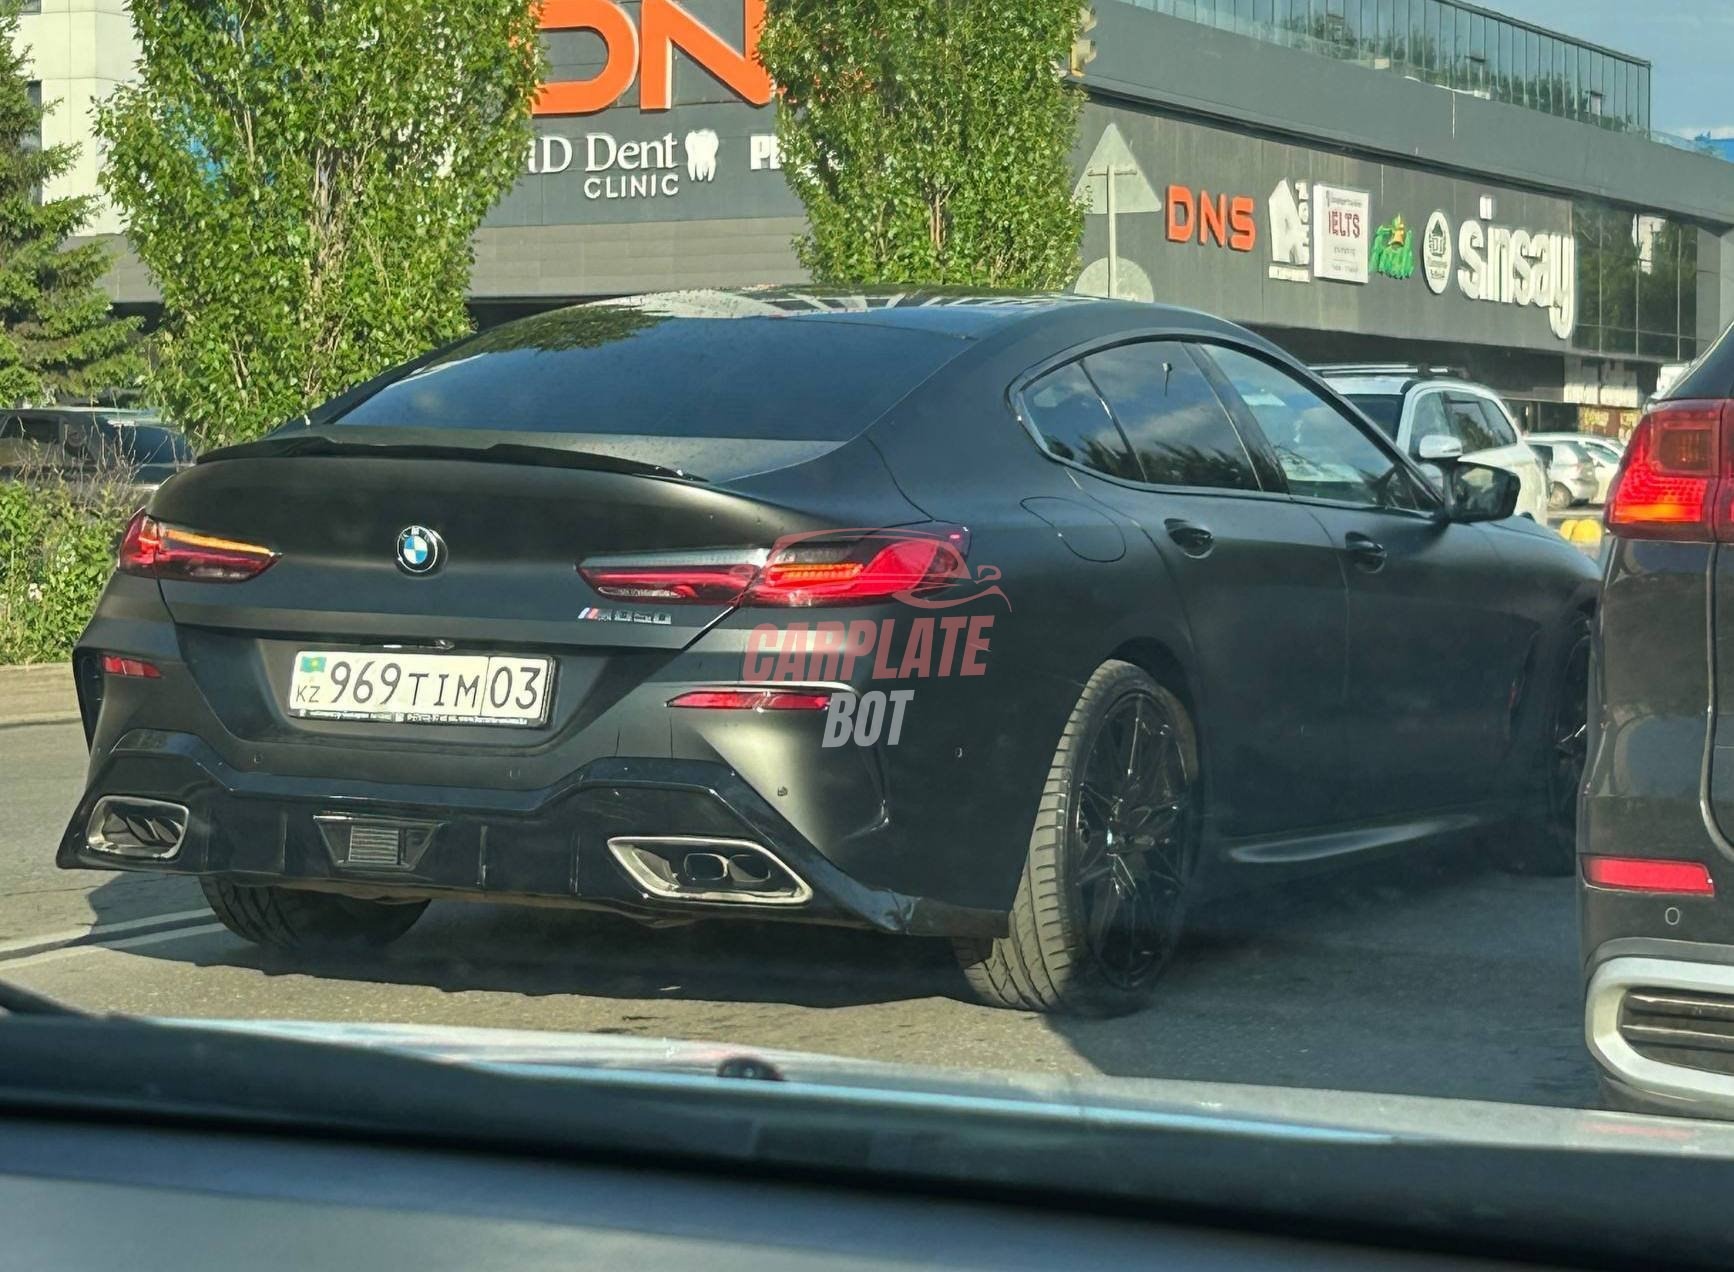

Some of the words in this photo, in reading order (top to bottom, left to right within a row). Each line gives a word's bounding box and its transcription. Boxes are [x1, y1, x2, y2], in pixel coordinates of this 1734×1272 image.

[529, 0, 774, 115] DN
[585, 131, 680, 172] Dent
[583, 173, 680, 199] CLINIC
[1166, 184, 1257, 252] DNS
[1327, 209, 1361, 238] IELTS
[1457, 195, 1575, 339] sinsay
[296, 685, 321, 703] KZ
[490, 666, 541, 709] 03
